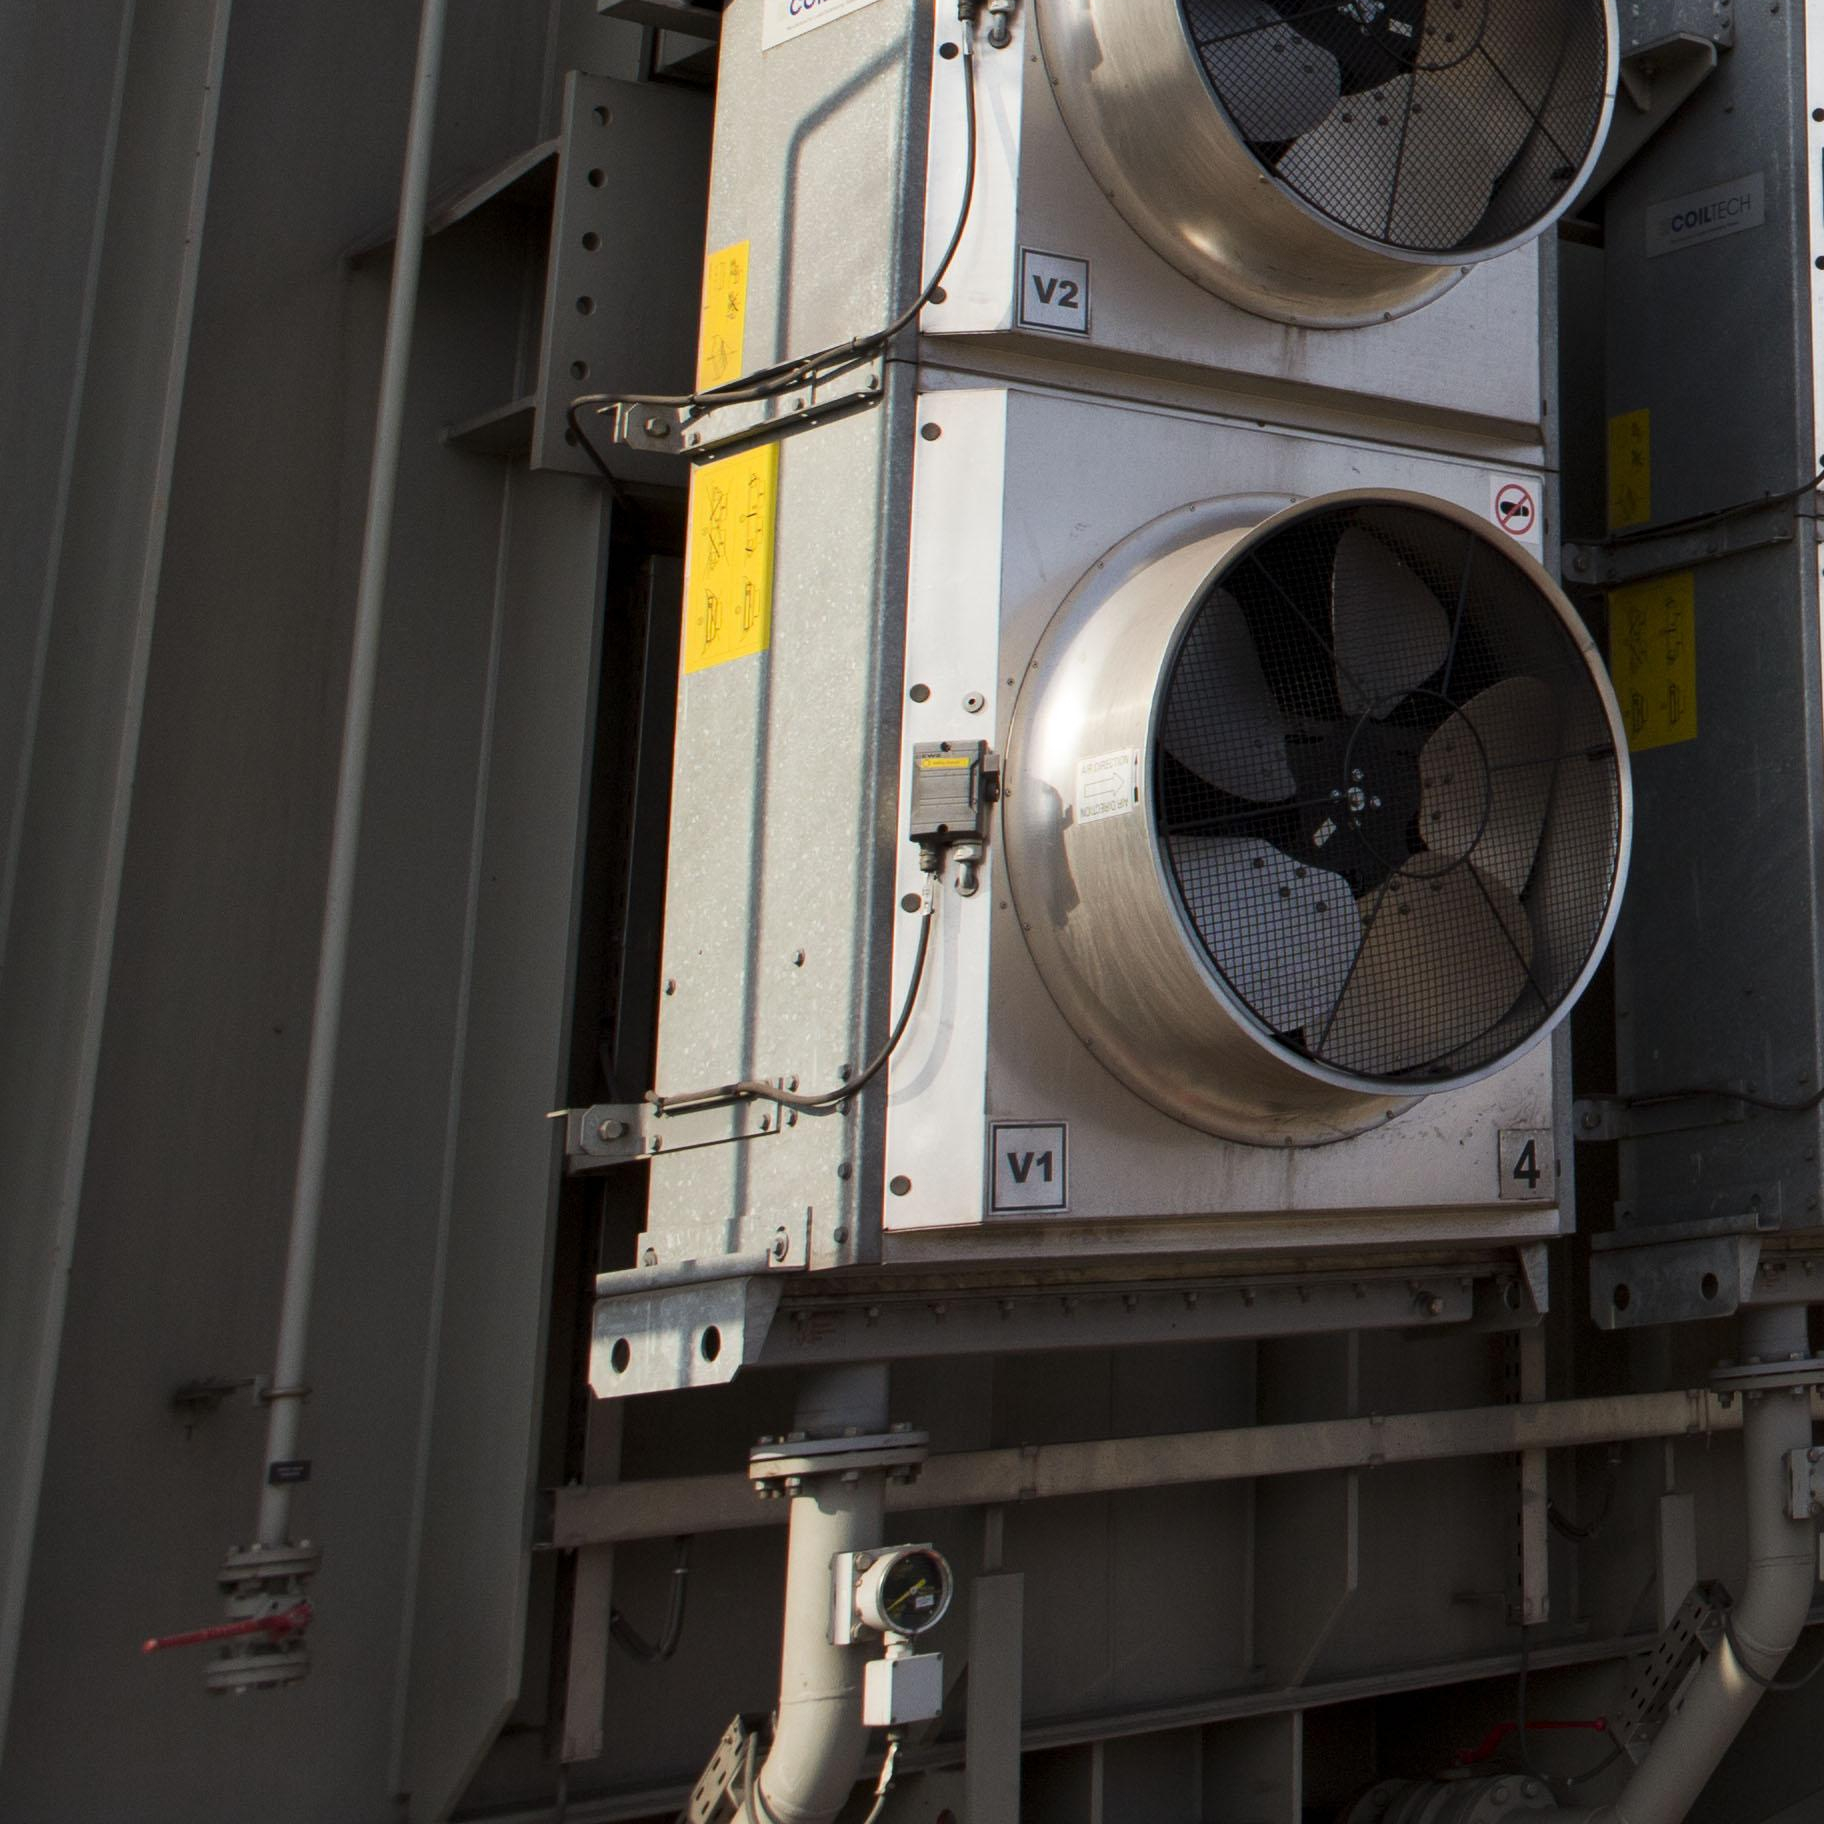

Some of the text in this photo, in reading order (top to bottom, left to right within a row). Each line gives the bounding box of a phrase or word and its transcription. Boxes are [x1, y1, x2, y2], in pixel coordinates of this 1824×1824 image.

[1671, 193, 1751, 233] COILTECH
[1032, 274, 1079, 309] V2
[1006, 1149, 1054, 1184] V1
[1513, 1139, 1541, 1189] 4
